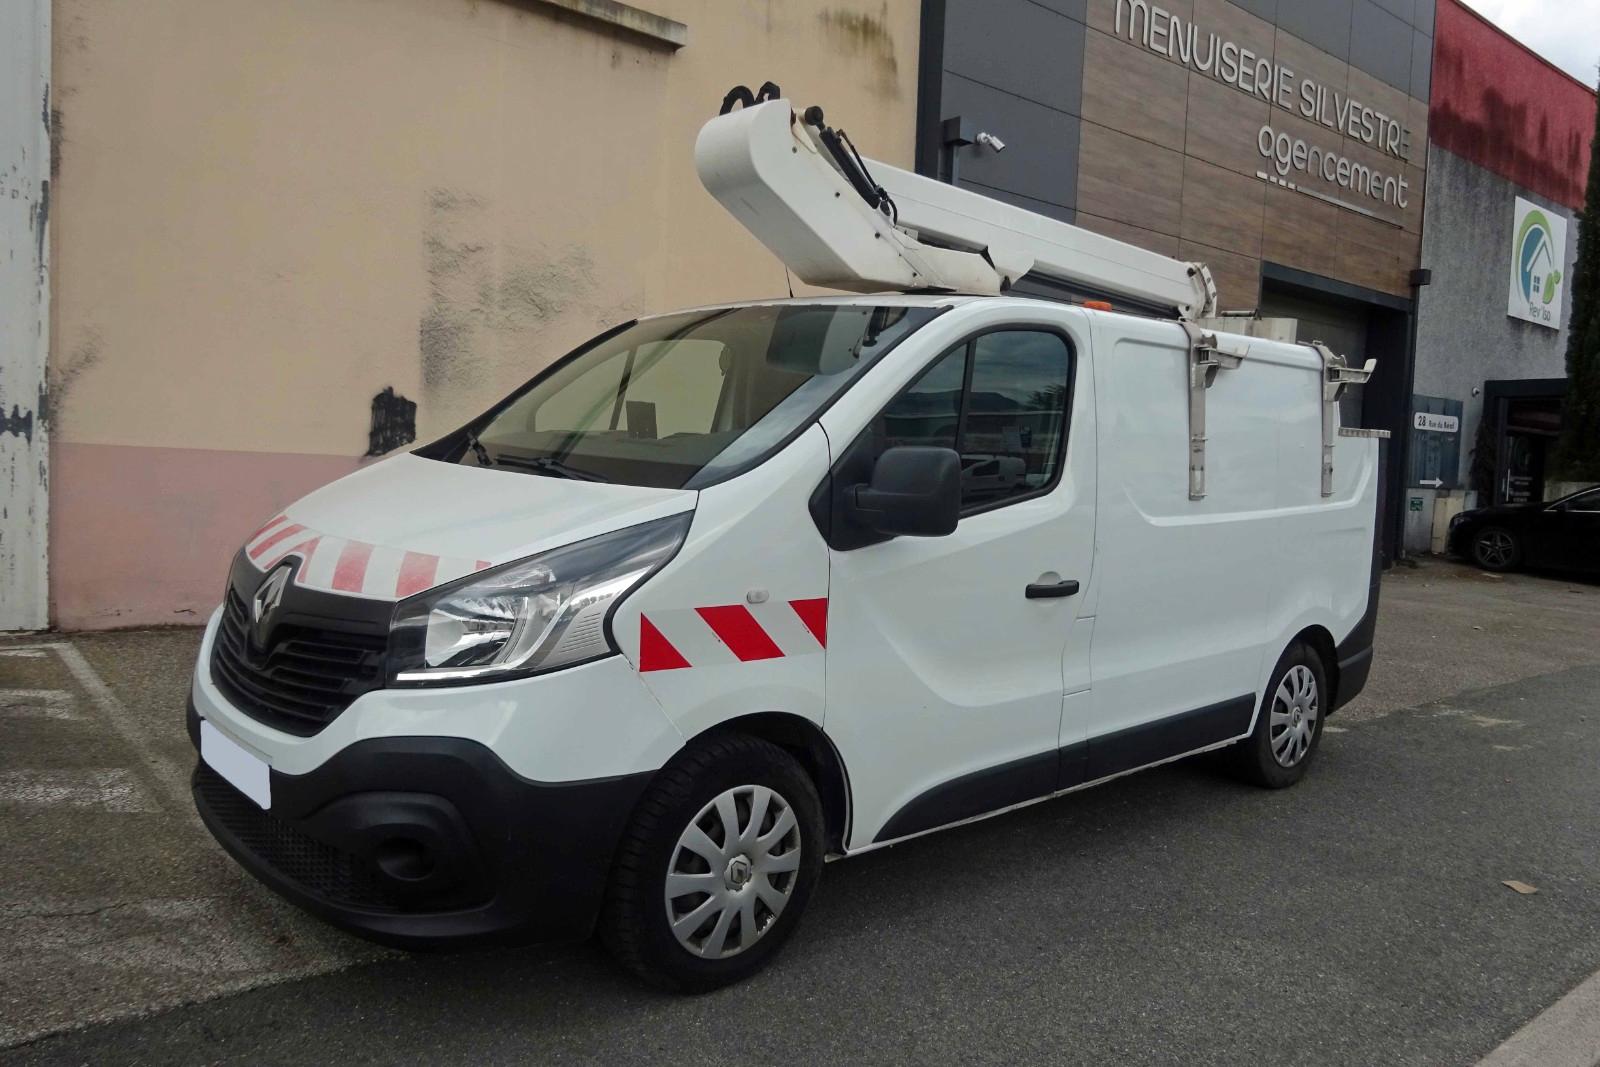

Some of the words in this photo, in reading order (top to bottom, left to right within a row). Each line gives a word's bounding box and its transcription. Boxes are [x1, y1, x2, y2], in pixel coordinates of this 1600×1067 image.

[1115, 0, 1294, 109] MENUISERIE
[1300, 79, 1410, 161] SILVESTRE
[1258, 125, 1408, 208] agencement
[1418, 415, 1426, 426] 28
